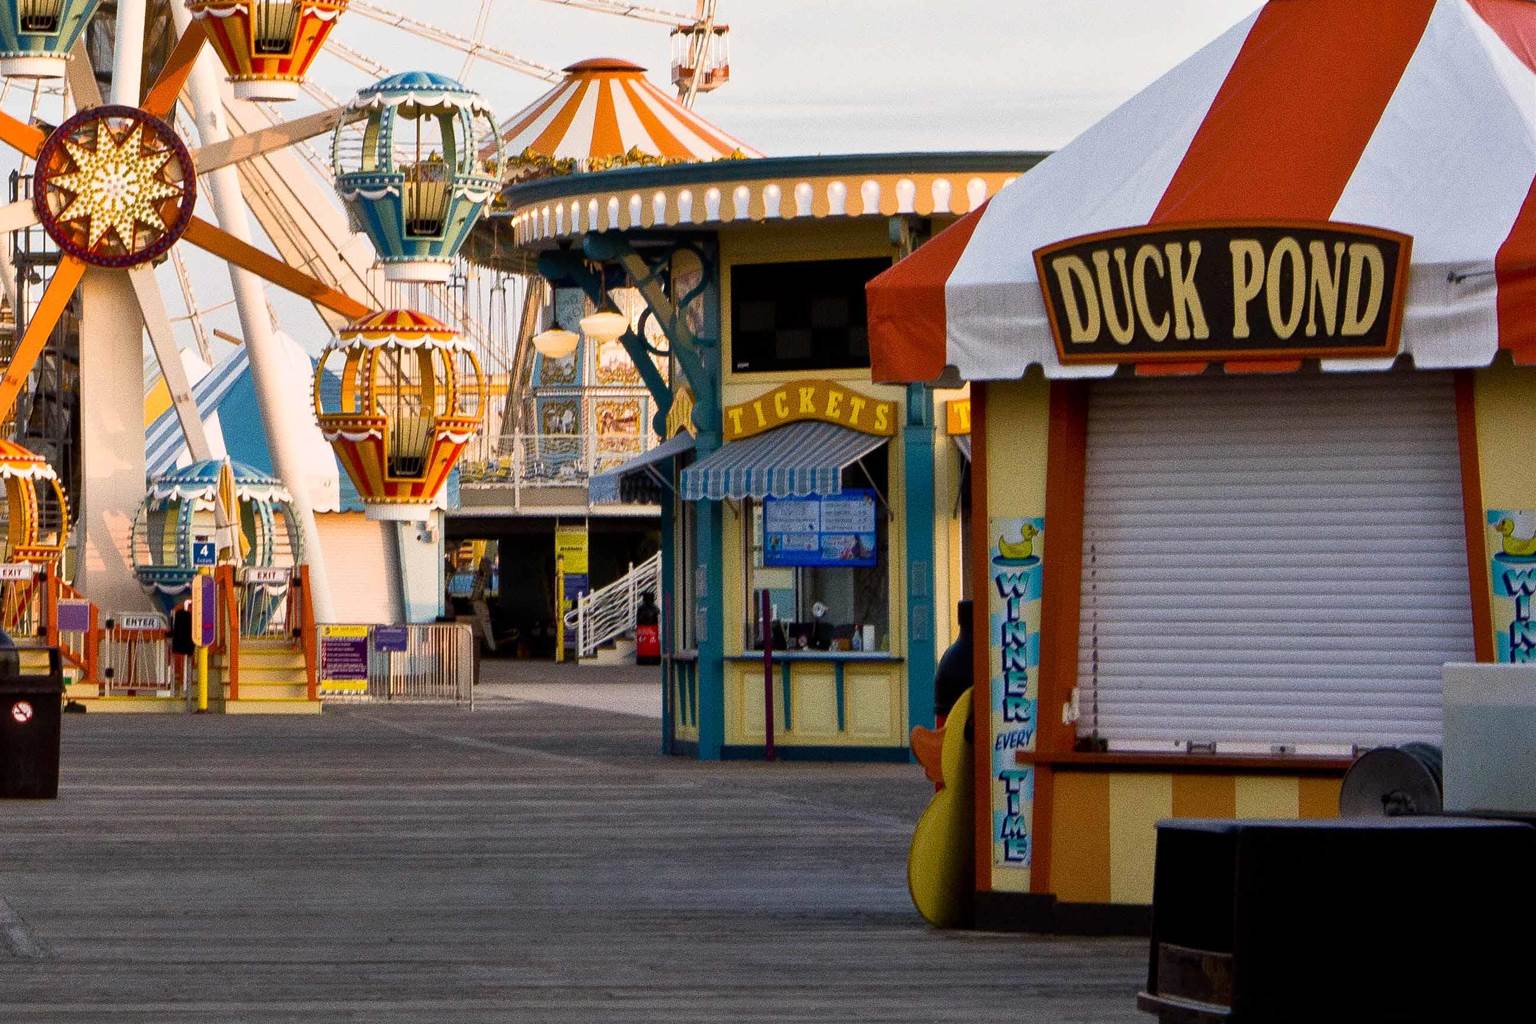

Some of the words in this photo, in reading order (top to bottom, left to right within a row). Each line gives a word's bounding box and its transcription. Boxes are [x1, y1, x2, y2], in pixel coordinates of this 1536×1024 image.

[1052, 240, 1209, 344] DUCK
[1229, 237, 1385, 340] POND
[728, 387, 889, 434] TICKETS
[200, 544, 209, 557] 4
[2, 569, 22, 577] EXIT
[257, 569, 276, 579] EXIT
[125, 617, 155, 627] ENTER
[995, 572, 1031, 723] WINNER
[995, 729, 1033, 752] EVERY
[998, 770, 1029, 862] TIME
